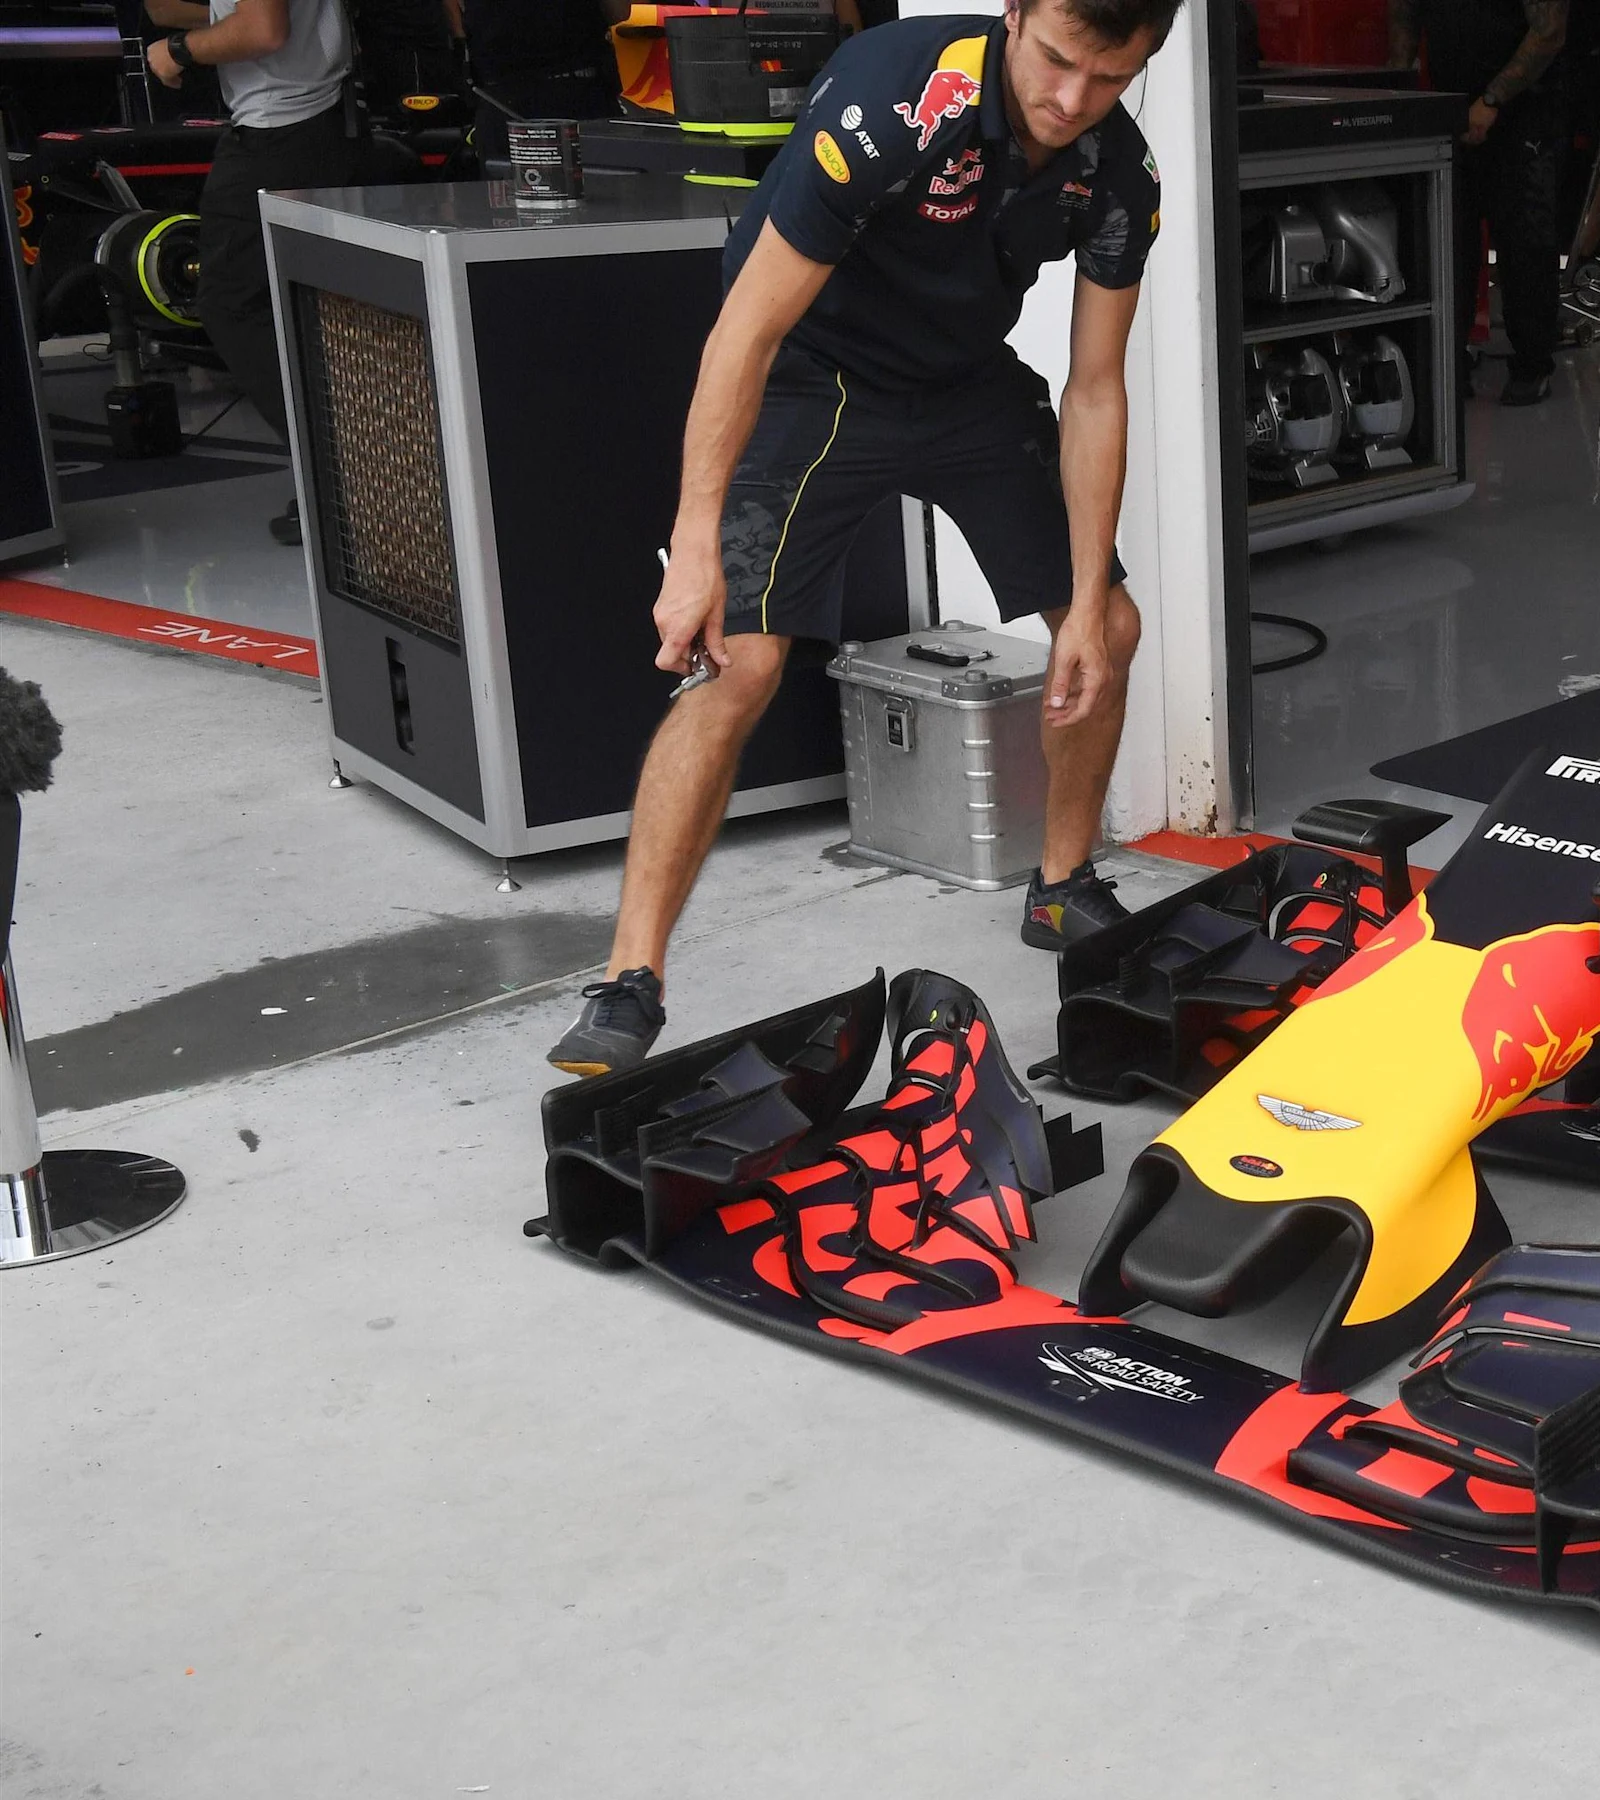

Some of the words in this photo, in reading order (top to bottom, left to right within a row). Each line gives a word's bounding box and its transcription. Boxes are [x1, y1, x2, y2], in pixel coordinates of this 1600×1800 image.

[820, 142, 845, 177] RAUCH
[855, 130, 881, 160] AT&T
[924, 203, 977, 220] TOTAL
[137, 621, 310, 659] LANE
[1069, 1351, 1094, 1365] FOR
[1090, 1360, 1138, 1381] ROAD
[1136, 1376, 1205, 1402] SAFETY
[1084, 1347, 1115, 1360] FIA
[1108, 1357, 1192, 1387] ACTION
